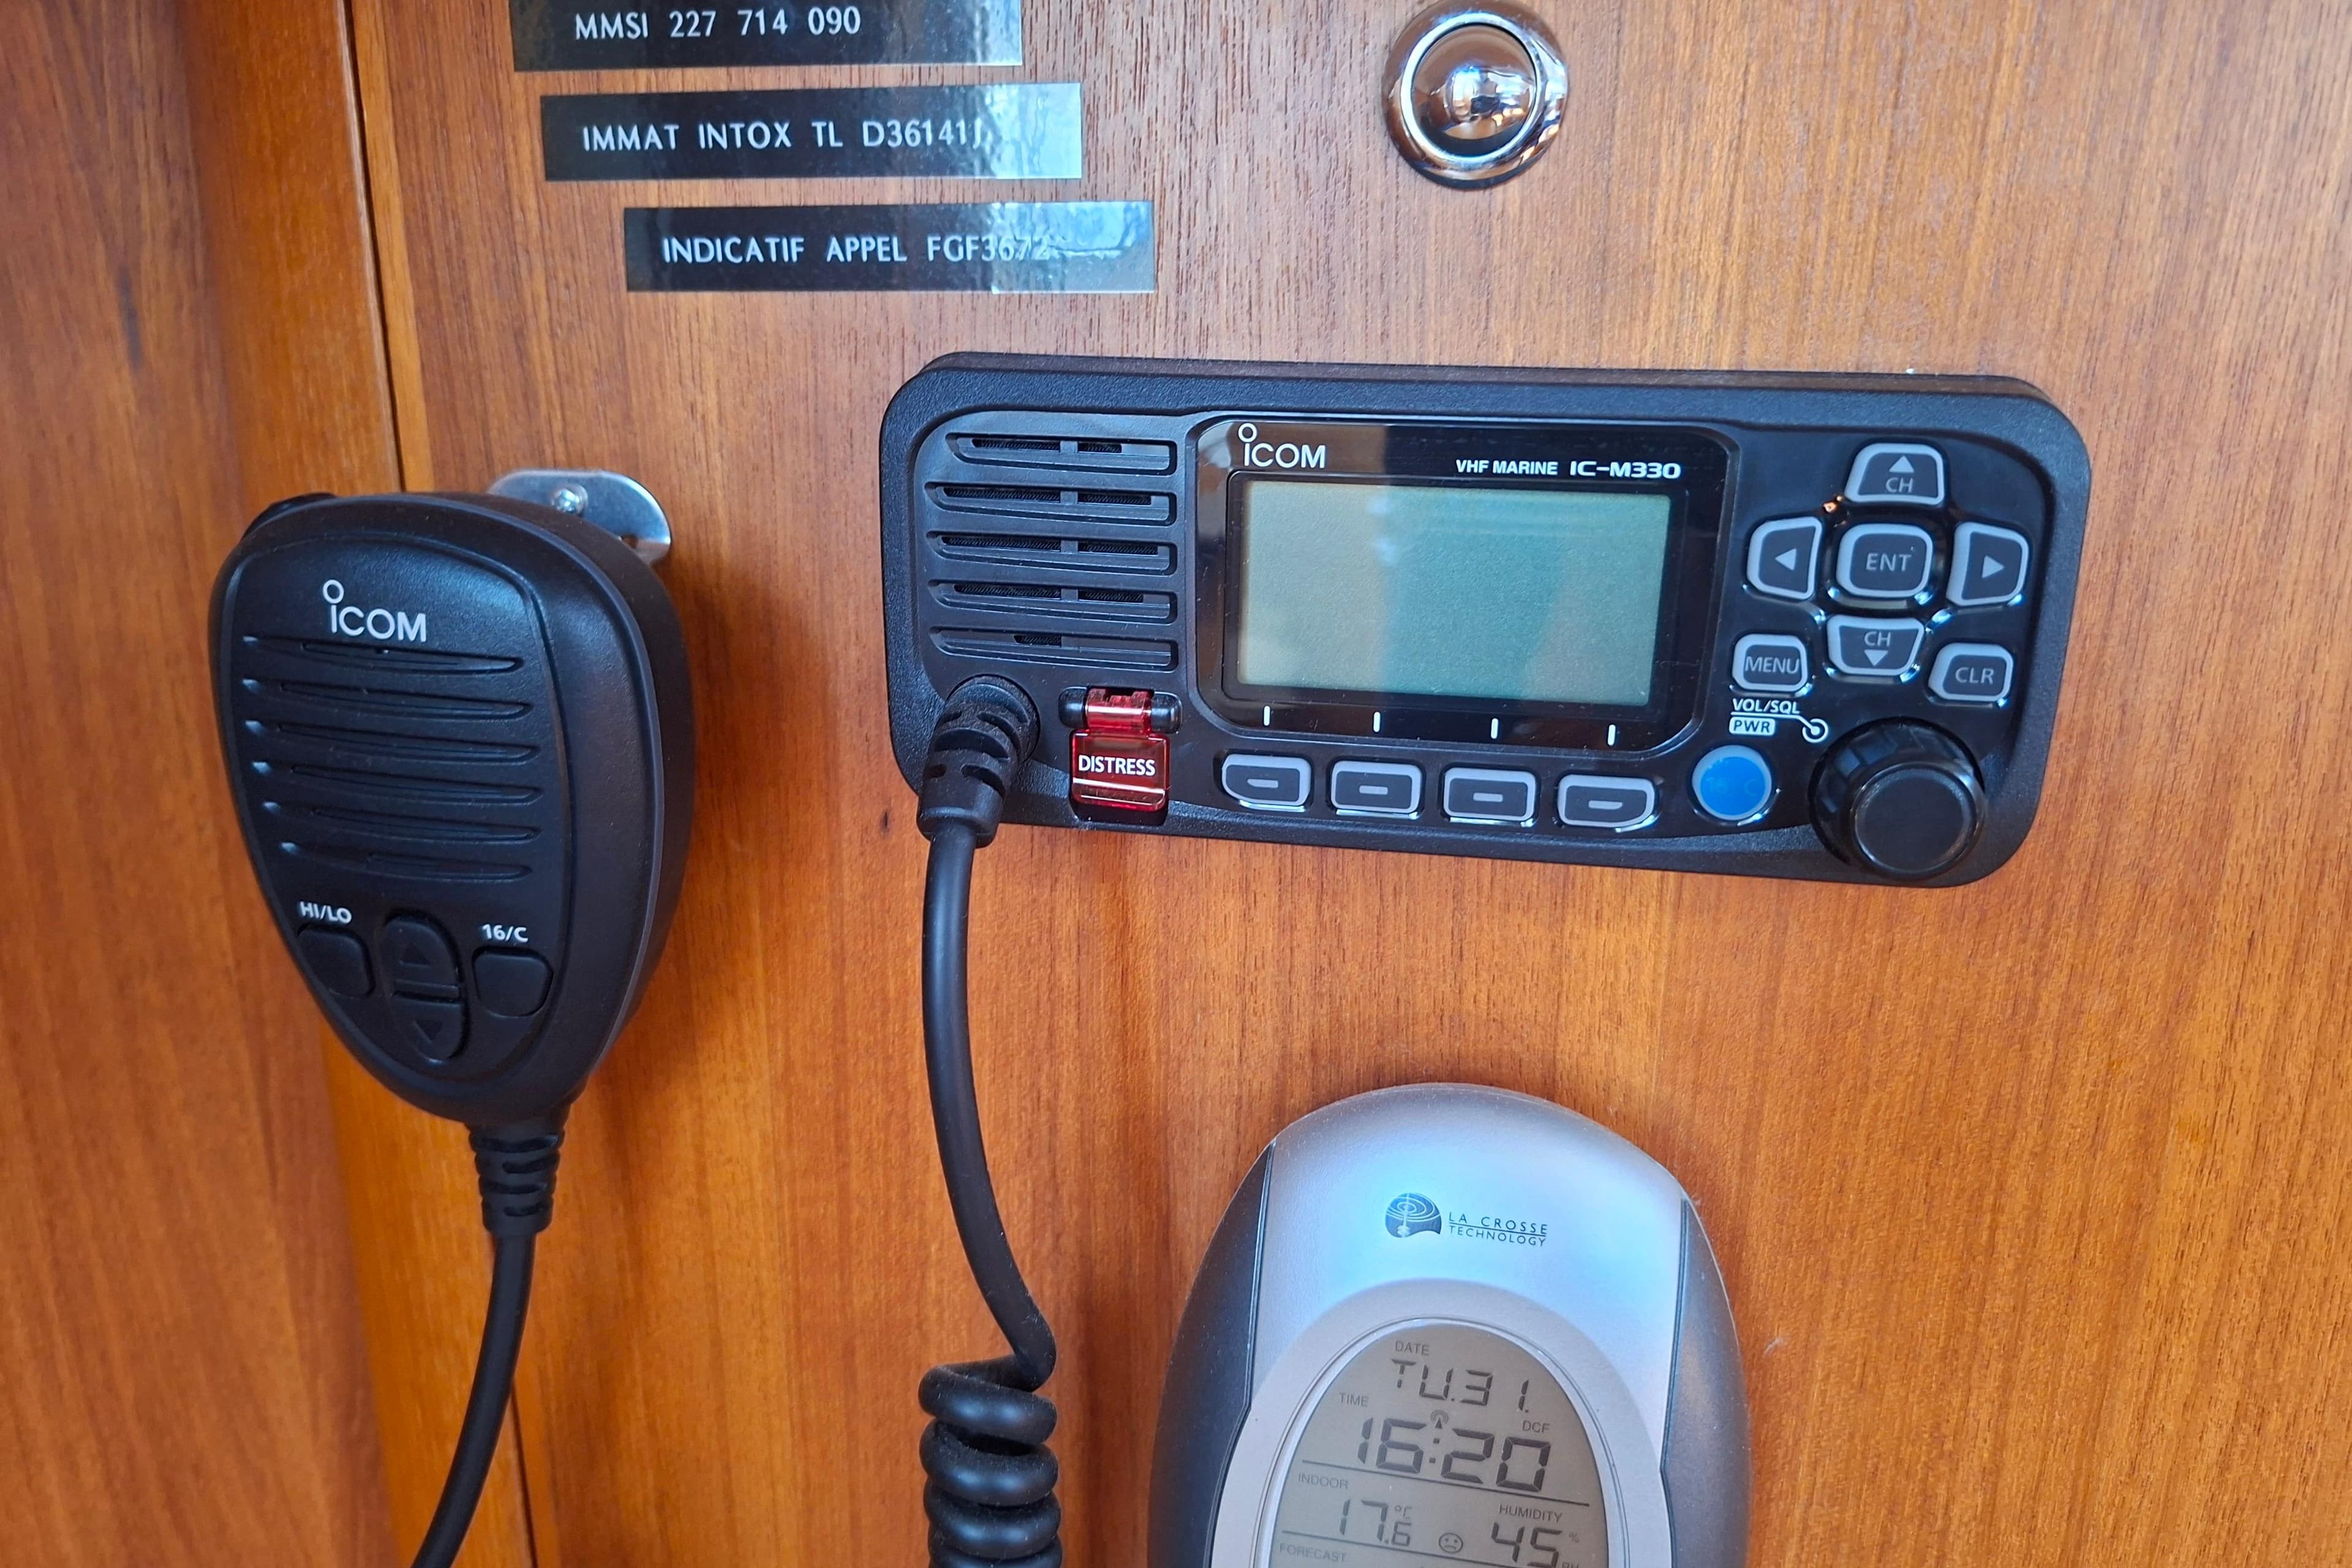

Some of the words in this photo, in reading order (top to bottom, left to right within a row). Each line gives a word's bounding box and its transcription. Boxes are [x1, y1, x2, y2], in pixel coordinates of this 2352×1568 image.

[575, 12, 649, 40] MMSI
[668, 10, 717, 38] 227
[737, 8, 788, 36] 714
[807, 6, 861, 36] 090
[582, 123, 680, 151] IMMAT
[698, 121, 792, 151] INTOX
[811, 121, 843, 148] TL
[662, 236, 805, 264] INDICATIF
[826, 235, 908, 263] APPEL
[1455, 459, 1490, 474] VHF
[1491, 460, 1559, 476] MARINE
[1569, 460, 1681, 480] IC-M330
[1885, 477, 1913, 494] CH
[1865, 552, 1912, 572] ENT
[1864, 631, 1891, 647] CH
[1745, 656, 1800, 674] MENU
[1954, 666, 1995, 686] CLR
[1732, 698, 1801, 715] VOL/SQL
[1733, 719, 1770, 733] PWR
[1078, 754, 1156, 777] DISTRESS
[299, 900, 353, 925] HI/LO
[481, 923, 529, 944] 16/C
[1449, 1211, 1468, 1224] LA
[1480, 1216, 1548, 1235] CROSSE
[1449, 1224, 1547, 1247] TECHNOLOGY
[1394, 1340, 1430, 1356] DATE
[1339, 1392, 1370, 1408] TIME
[1521, 1420, 1551, 1434] DCF
[1357, 1417, 1551, 1493] 16:20
[1298, 1471, 1349, 1490] INDOOR
[1498, 1504, 1563, 1523] HUMIDITY
[1279, 1542, 1348, 1563] FORECAST
